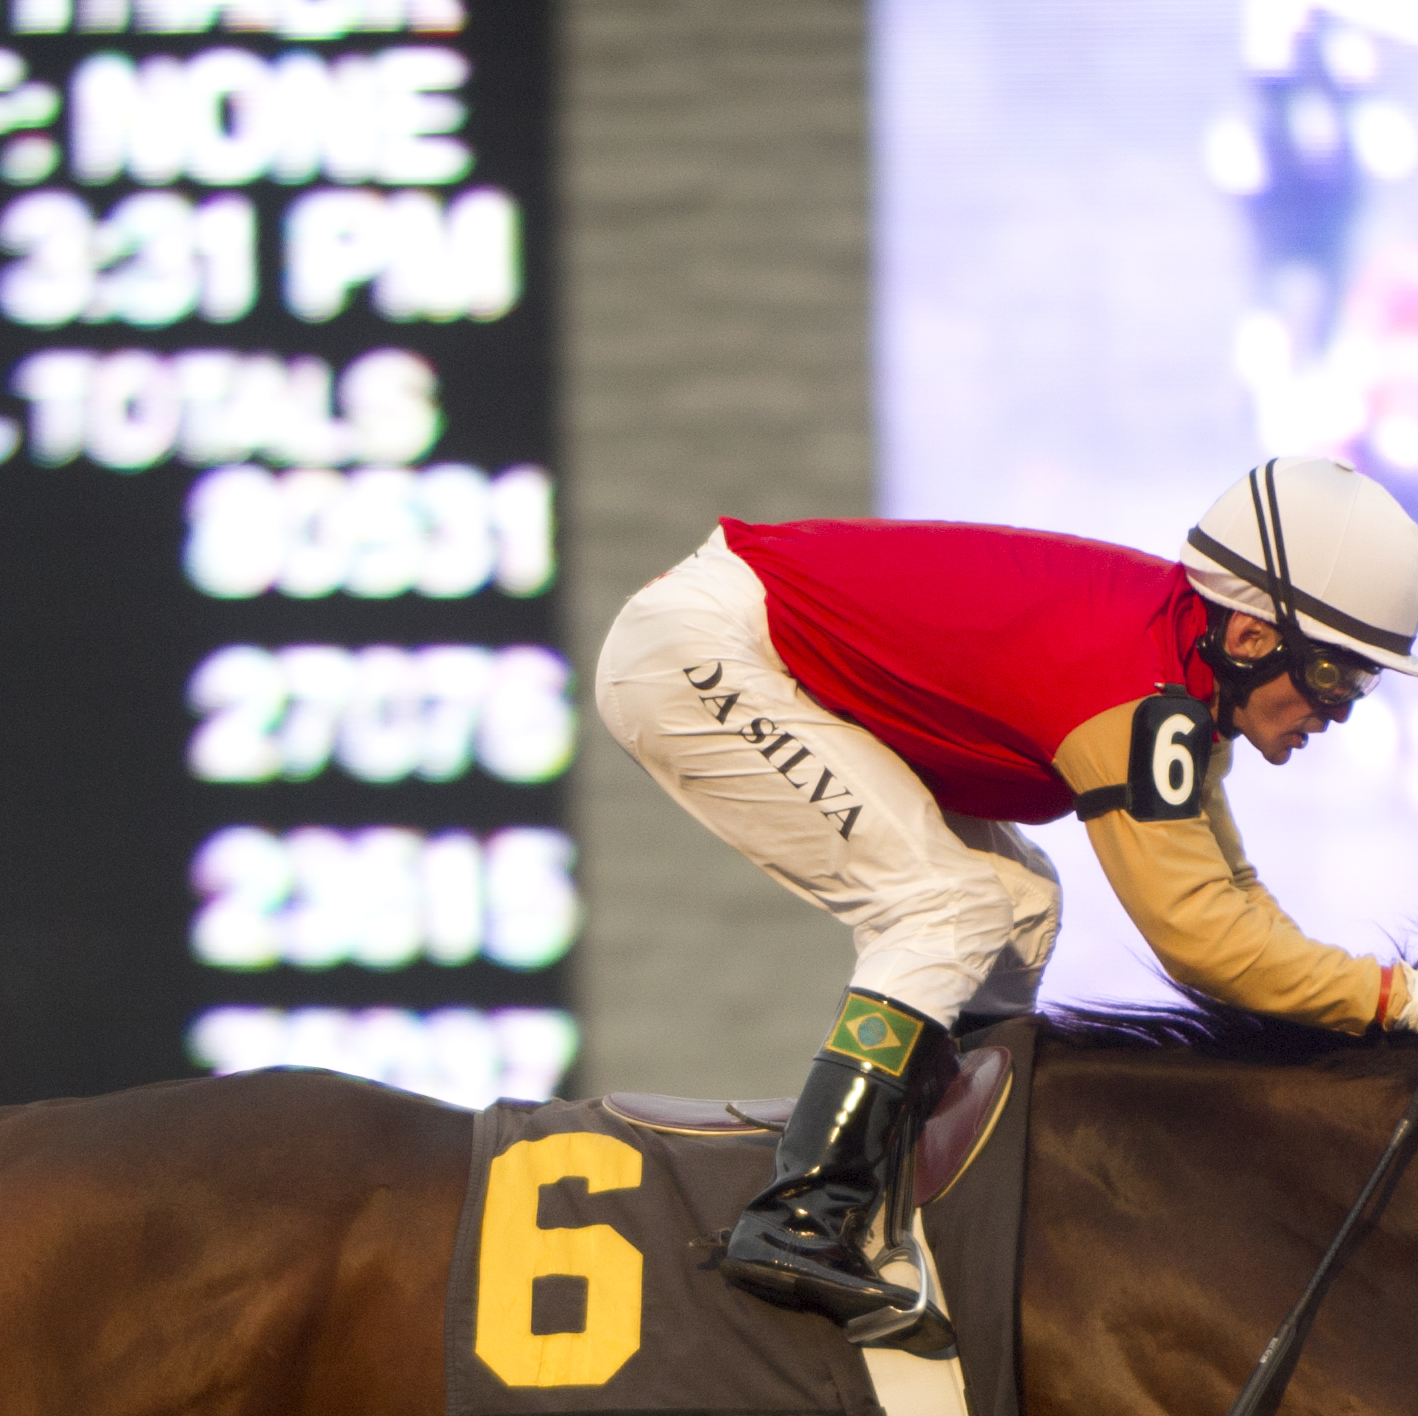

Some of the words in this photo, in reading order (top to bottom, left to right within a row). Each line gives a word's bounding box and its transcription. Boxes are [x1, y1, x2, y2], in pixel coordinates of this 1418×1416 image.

[69, 46, 471, 186] NONE
[283, 190, 519, 322] PM
[15, 349, 441, 462] TOTALS
[683, 661, 741, 725] DA
[737, 716, 863, 842] SILVA
[1153, 713, 1196, 805] 6
[475, 1131, 643, 1387] 6
